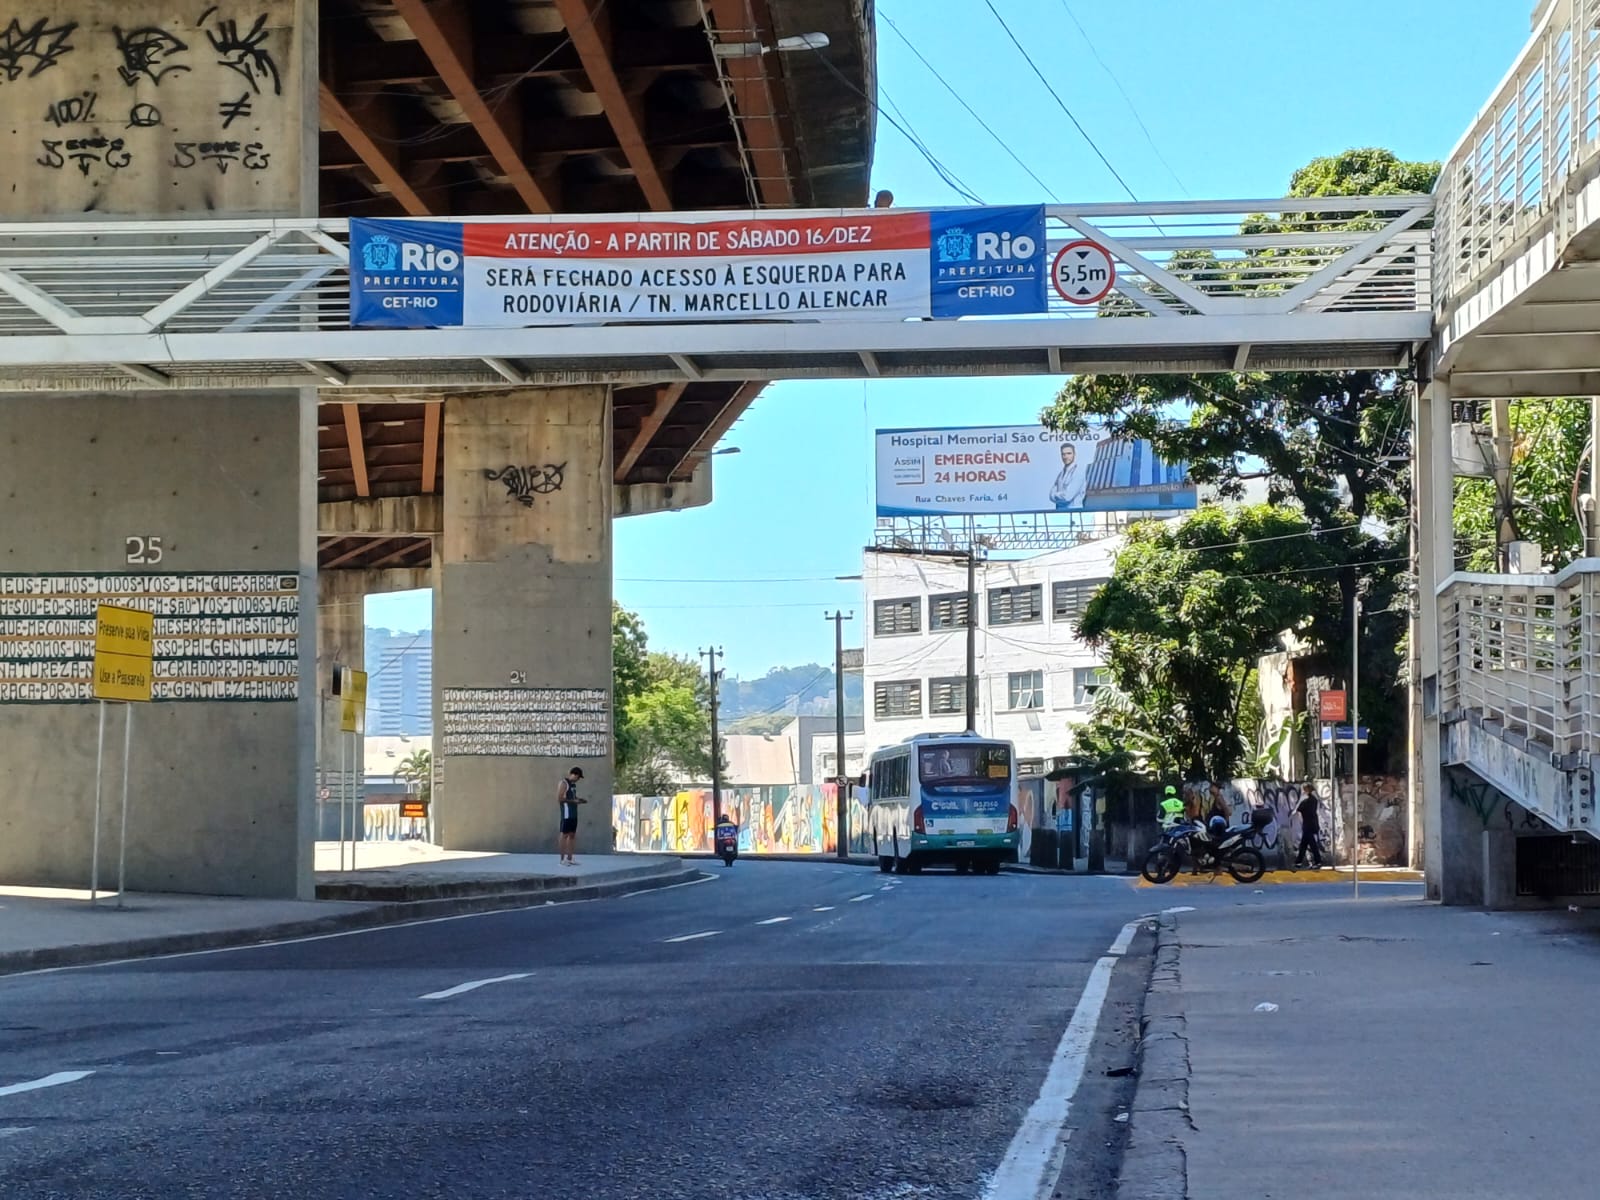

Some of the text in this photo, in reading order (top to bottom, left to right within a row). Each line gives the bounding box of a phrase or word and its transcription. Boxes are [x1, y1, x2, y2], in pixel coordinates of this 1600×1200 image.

[505, 231, 590, 254] ATENÇÃO
[606, 233, 619, 251] A
[624, 232, 691, 251] PARTIR
[696, 231, 720, 250] DE
[726, 227, 800, 249] SÁBADO
[806, 226, 872, 245] 16/DEZ
[977, 232, 1035, 261] Rio
[402, 242, 460, 271] Rio
[486, 262, 906, 287] SERÁ FECHADO ACESSO À ESQUERDA PARA
[939, 264, 1035, 277] PREFEITURA
[1059, 265, 1107, 283] 5,5m
[364, 276, 459, 286] PREFEITURA
[958, 285, 1015, 299] CET-RIO
[382, 296, 438, 309] CET-RIO
[503, 291, 622, 313] RODOVIÁRIA
[648, 294, 676, 312] TN.
[685, 291, 790, 312] MARCELLO
[797, 289, 888, 309] ALENCAR
[891, 435, 943, 448] Hospital
[948, 432, 1007, 445] Memorial
[934, 450, 1030, 466] EMERGÊNCIA
[934, 472, 950, 483] 24
[954, 470, 1006, 482] HORAS
[126, 536, 162, 564] 25
[510, 671, 527, 684] 24
